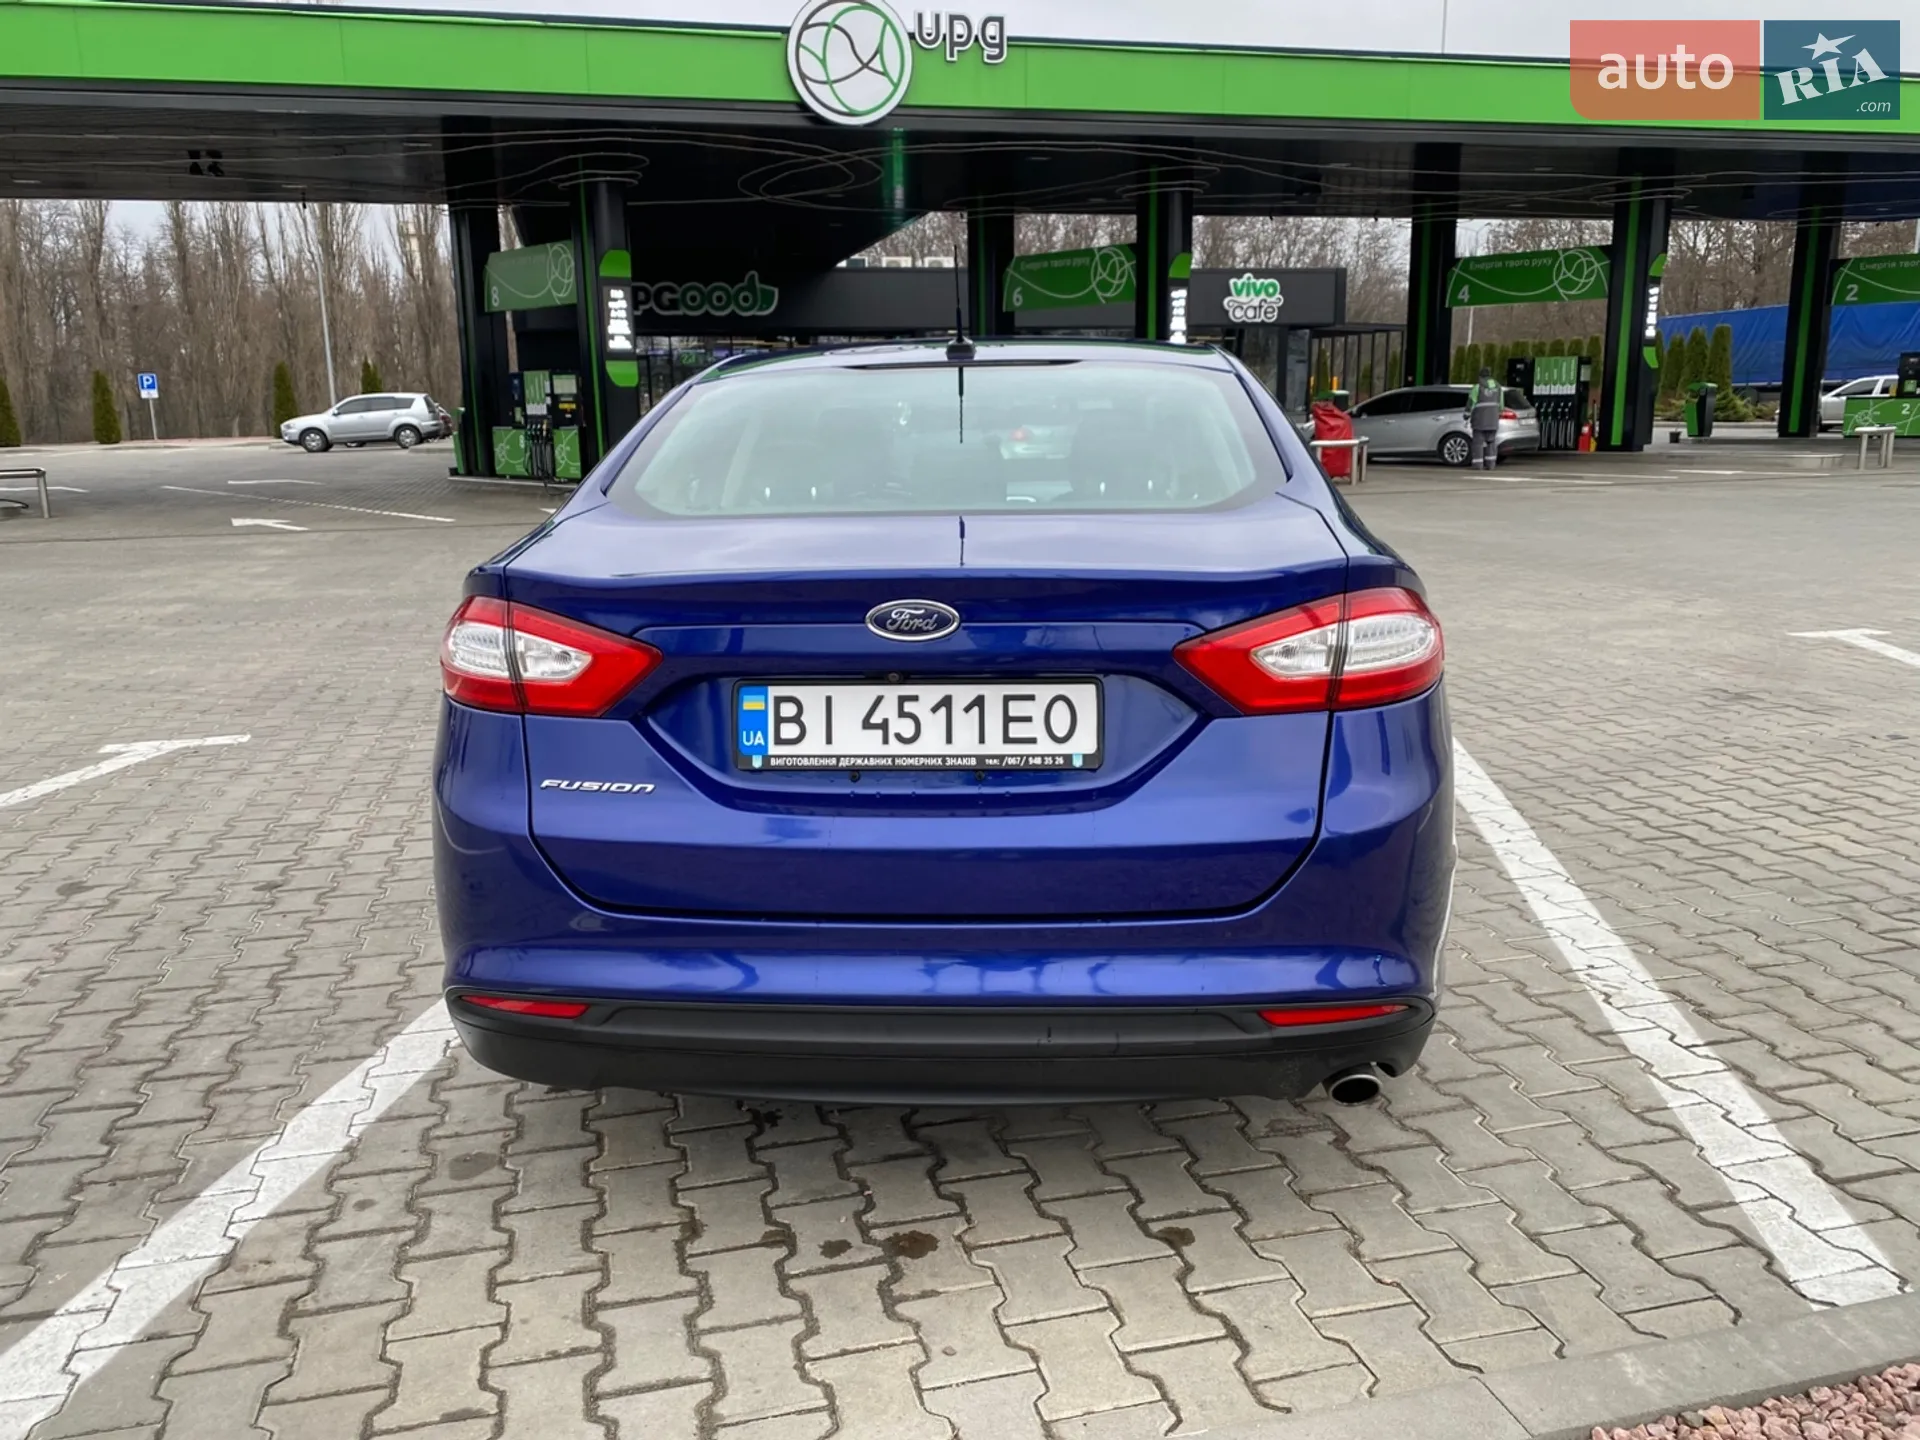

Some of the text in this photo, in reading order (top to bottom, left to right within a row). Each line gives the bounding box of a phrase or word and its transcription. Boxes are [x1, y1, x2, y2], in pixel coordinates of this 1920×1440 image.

[914, 11, 1007, 63] upg
[1230, 273, 1280, 298] vivo
[1457, 284, 1470, 302] 4
[1845, 283, 1859, 301] 2
[491, 286, 500, 307] 8
[1012, 286, 1023, 306] 6
[1901, 403, 1911, 415] 2
[886, 608, 938, 631] Ford
[742, 730, 765, 746] UA
[770, 757, 837, 766] ВИГОТОВЛЕННЯ
[838, 757, 893, 767] ДЕРЖАВНИХ
[895, 757, 943, 766] НОМЕРНИХ
[945, 756, 977, 766] ЗНАКІВ
[1028, 756, 1042, 766] 948
[1044, 756, 1053, 765] 35
[1054, 756, 1064, 765] 26
[540, 779, 656, 794] FUSION
